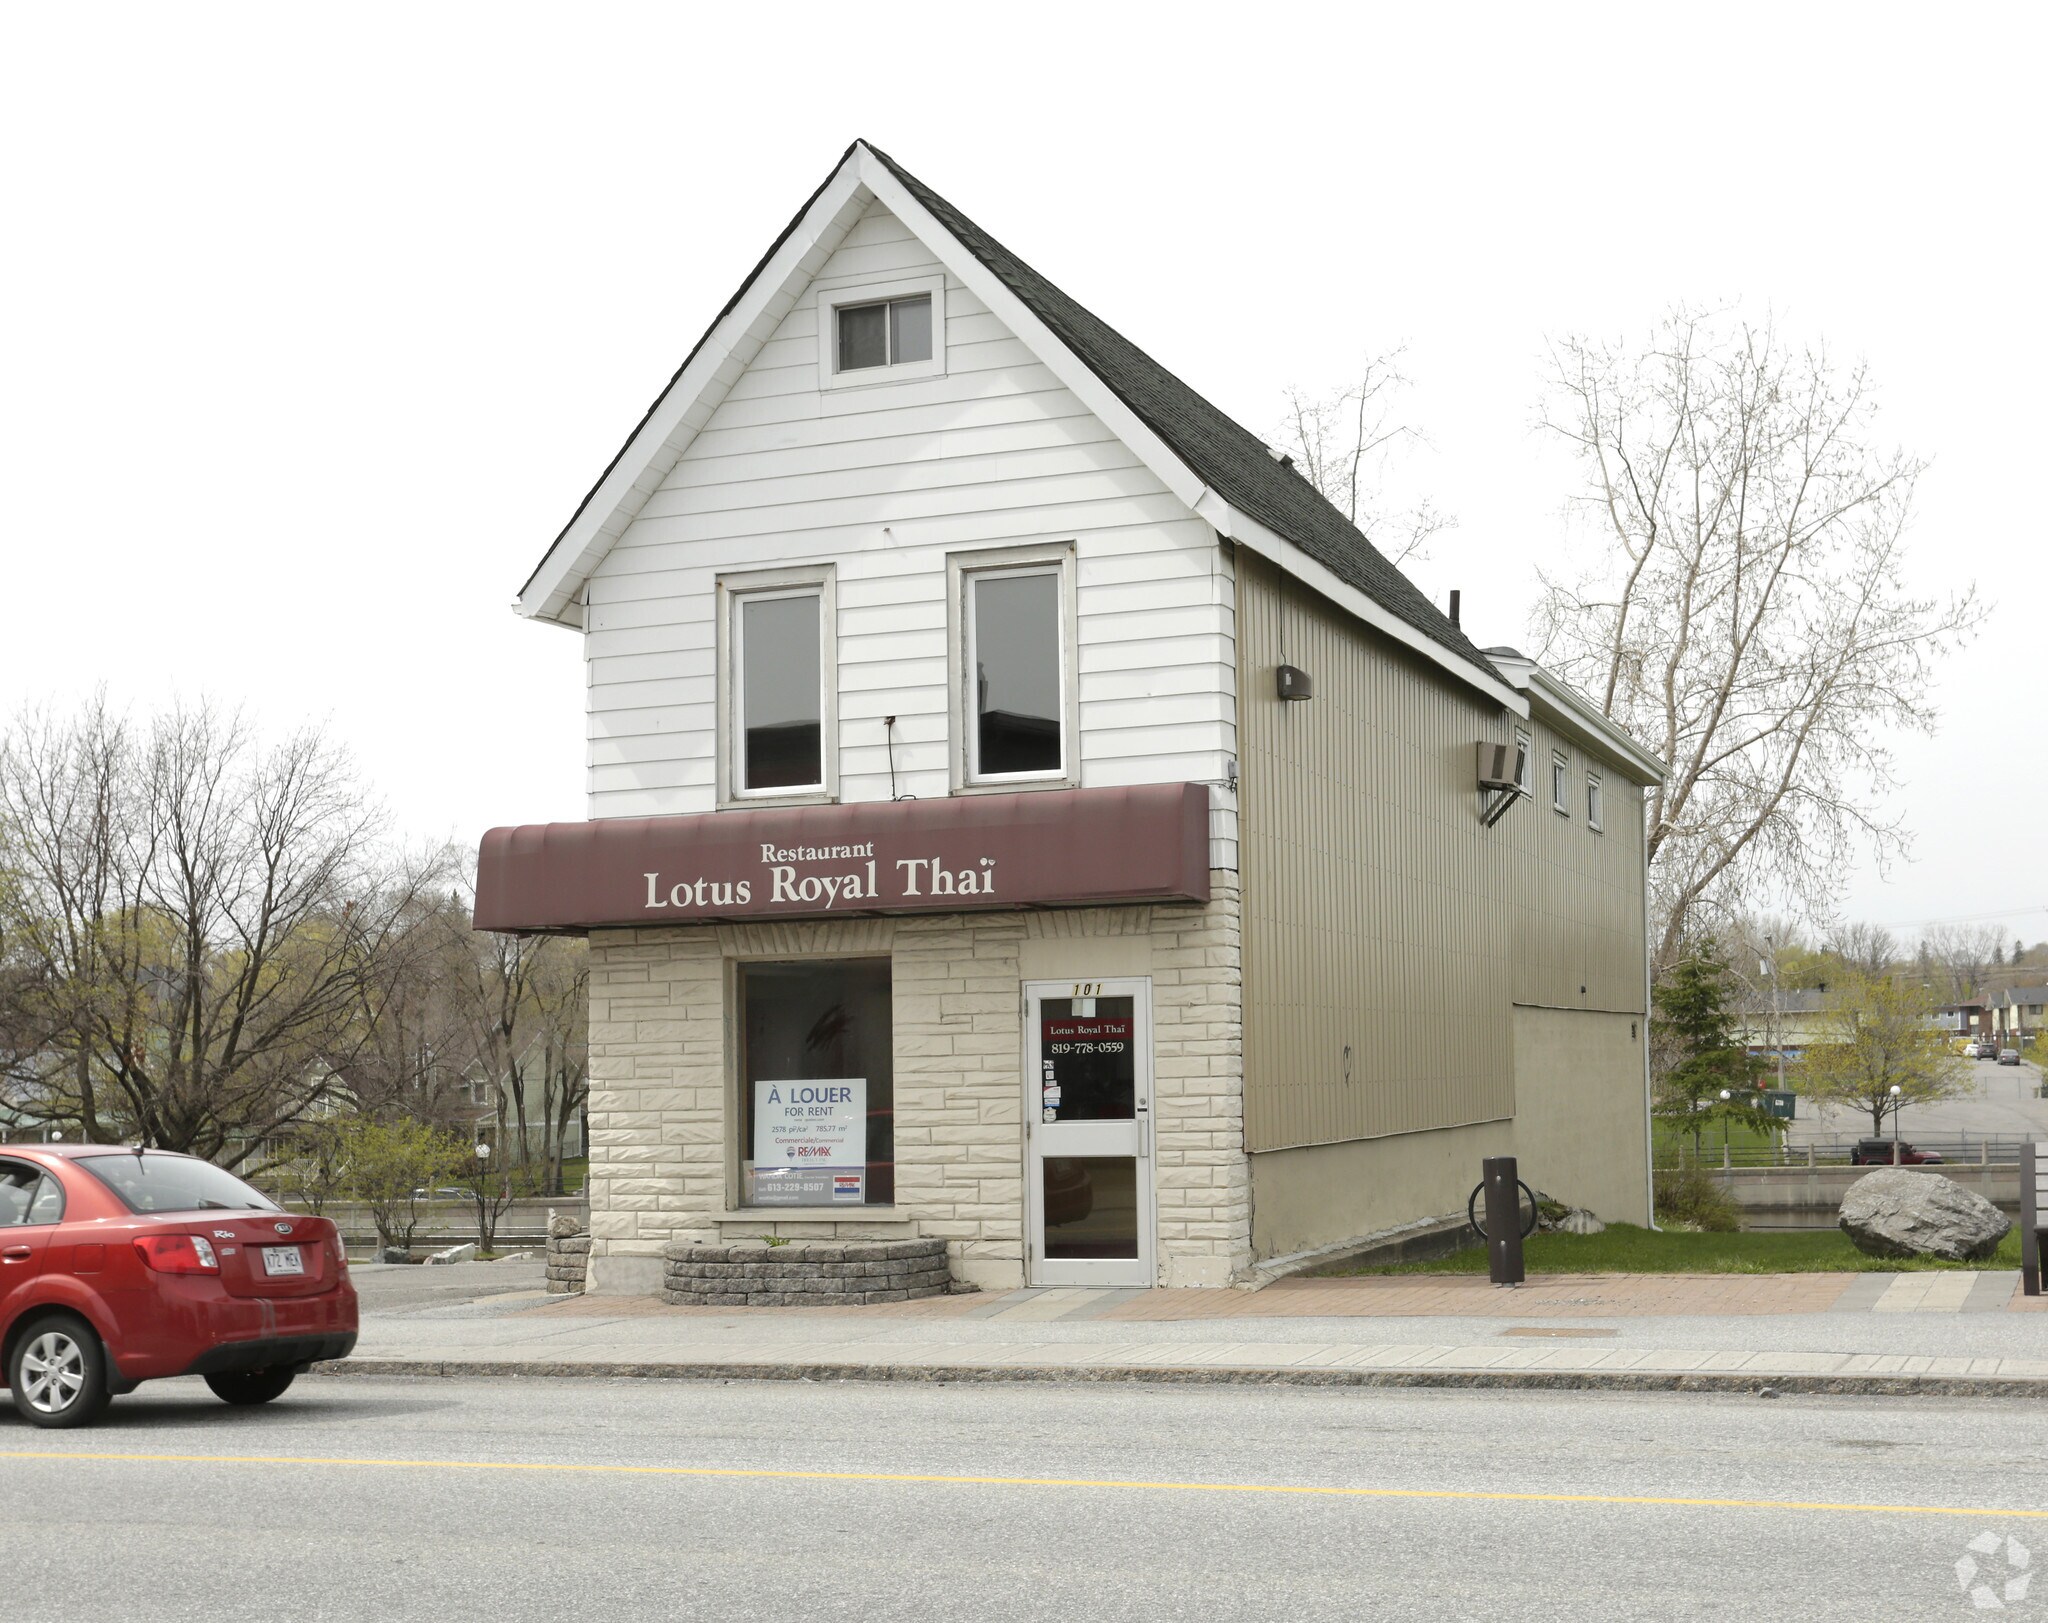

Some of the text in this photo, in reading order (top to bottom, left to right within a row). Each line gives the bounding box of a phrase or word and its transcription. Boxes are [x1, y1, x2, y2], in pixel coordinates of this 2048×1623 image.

[760, 841, 874, 863] Restaurant
[643, 856, 996, 909] Lotus Royal Thaï
[1074, 983, 1102, 996] 101
[1050, 1026, 1075, 1035] Lotus
[1077, 1024, 1101, 1036] Royal
[1051, 1042, 1124, 1054] 819-778-0559
[768, 1084, 852, 1104] À LOUER
[784, 1106, 834, 1117] FOR RENT
[798, 1146, 831, 1157] RE/MAX
[213, 1230, 235, 1238] Rio
